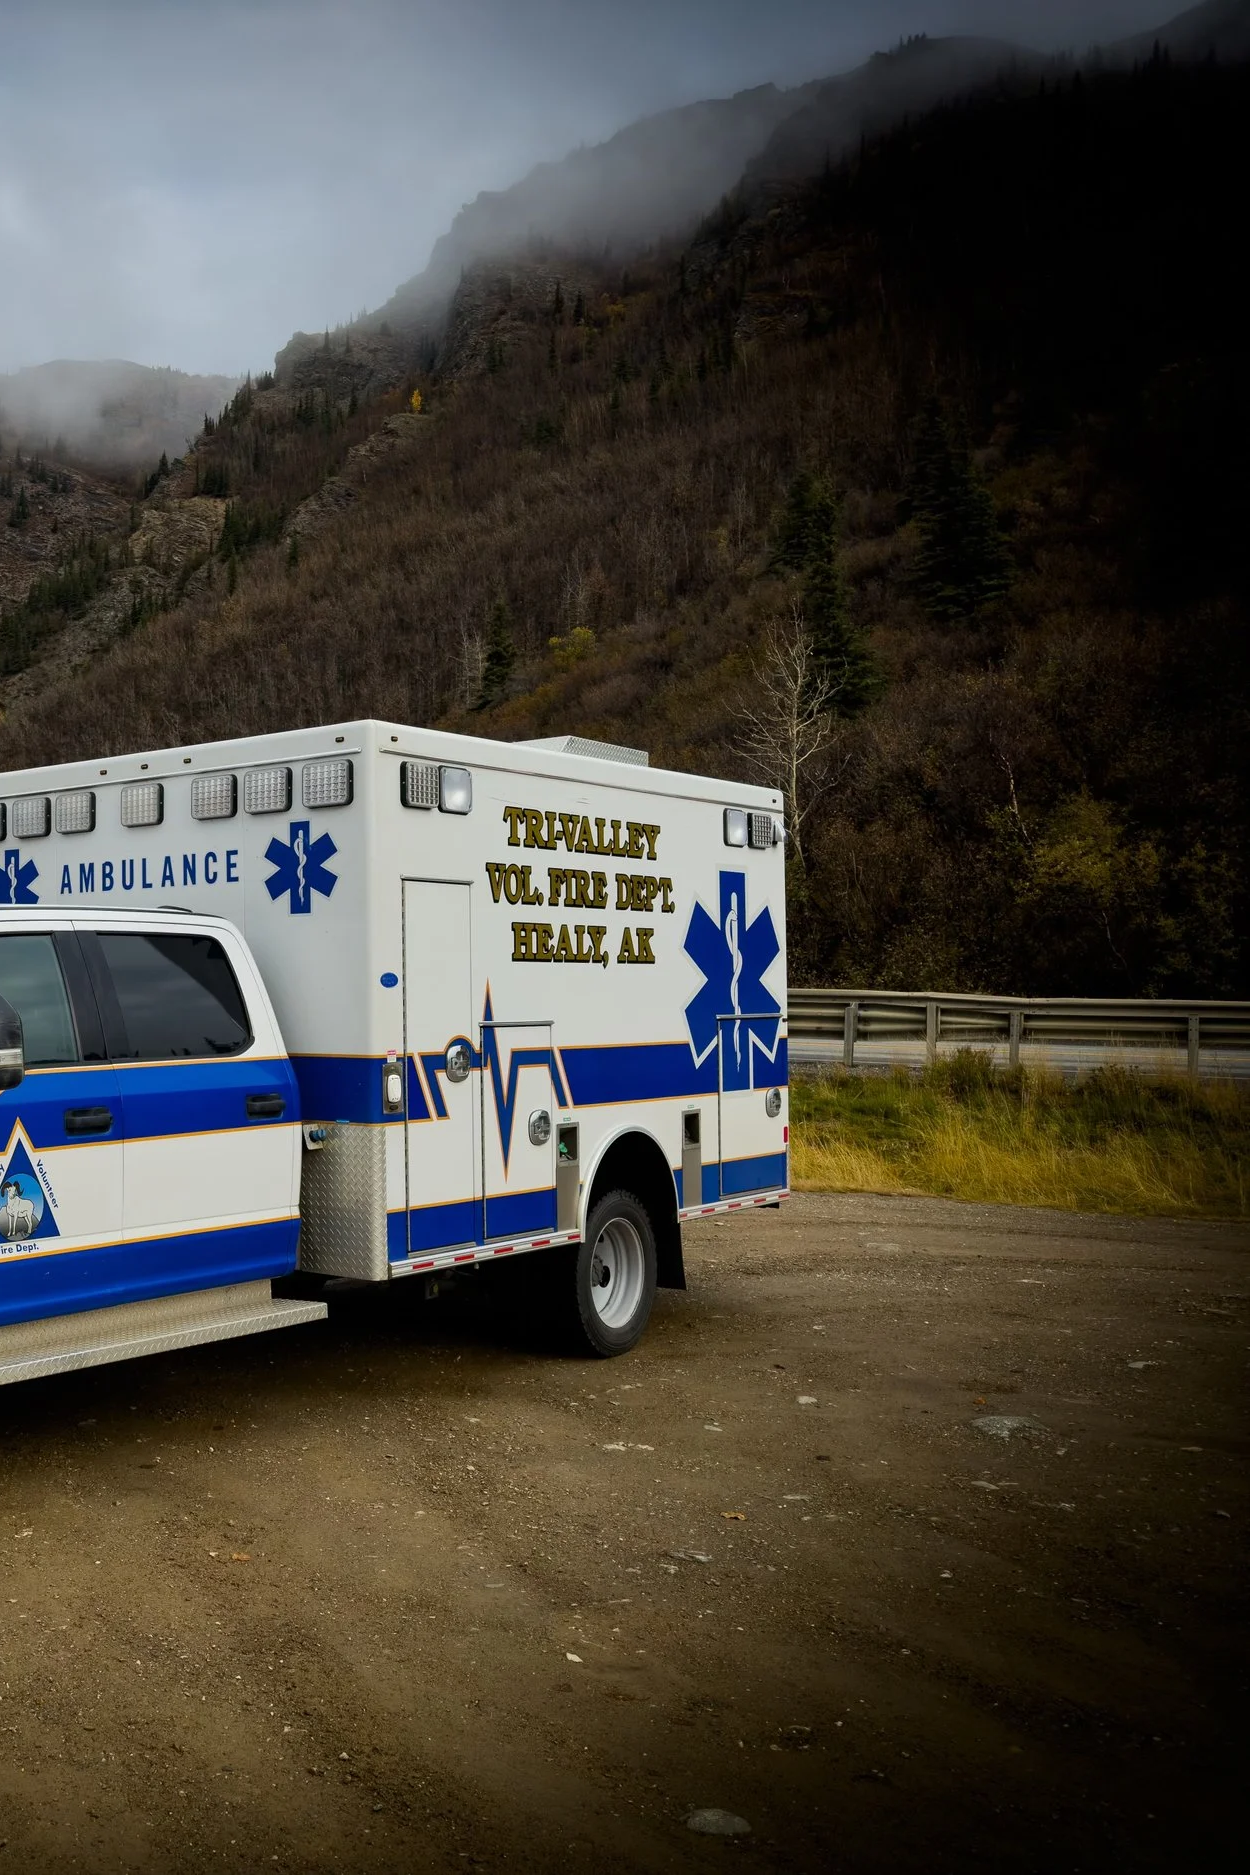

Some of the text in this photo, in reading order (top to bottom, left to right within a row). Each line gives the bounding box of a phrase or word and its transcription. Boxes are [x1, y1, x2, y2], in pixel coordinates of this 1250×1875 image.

[503, 806, 661, 861] TRI-VALLEY
[60, 850, 240, 895] AMBULANCE
[485, 862, 676, 914] VOL. FIRE DEPT.
[511, 922, 656, 970] HEALY, AK
[36, 1159, 59, 1209] Volunteer
[16, 1243, 40, 1253] Dept.
